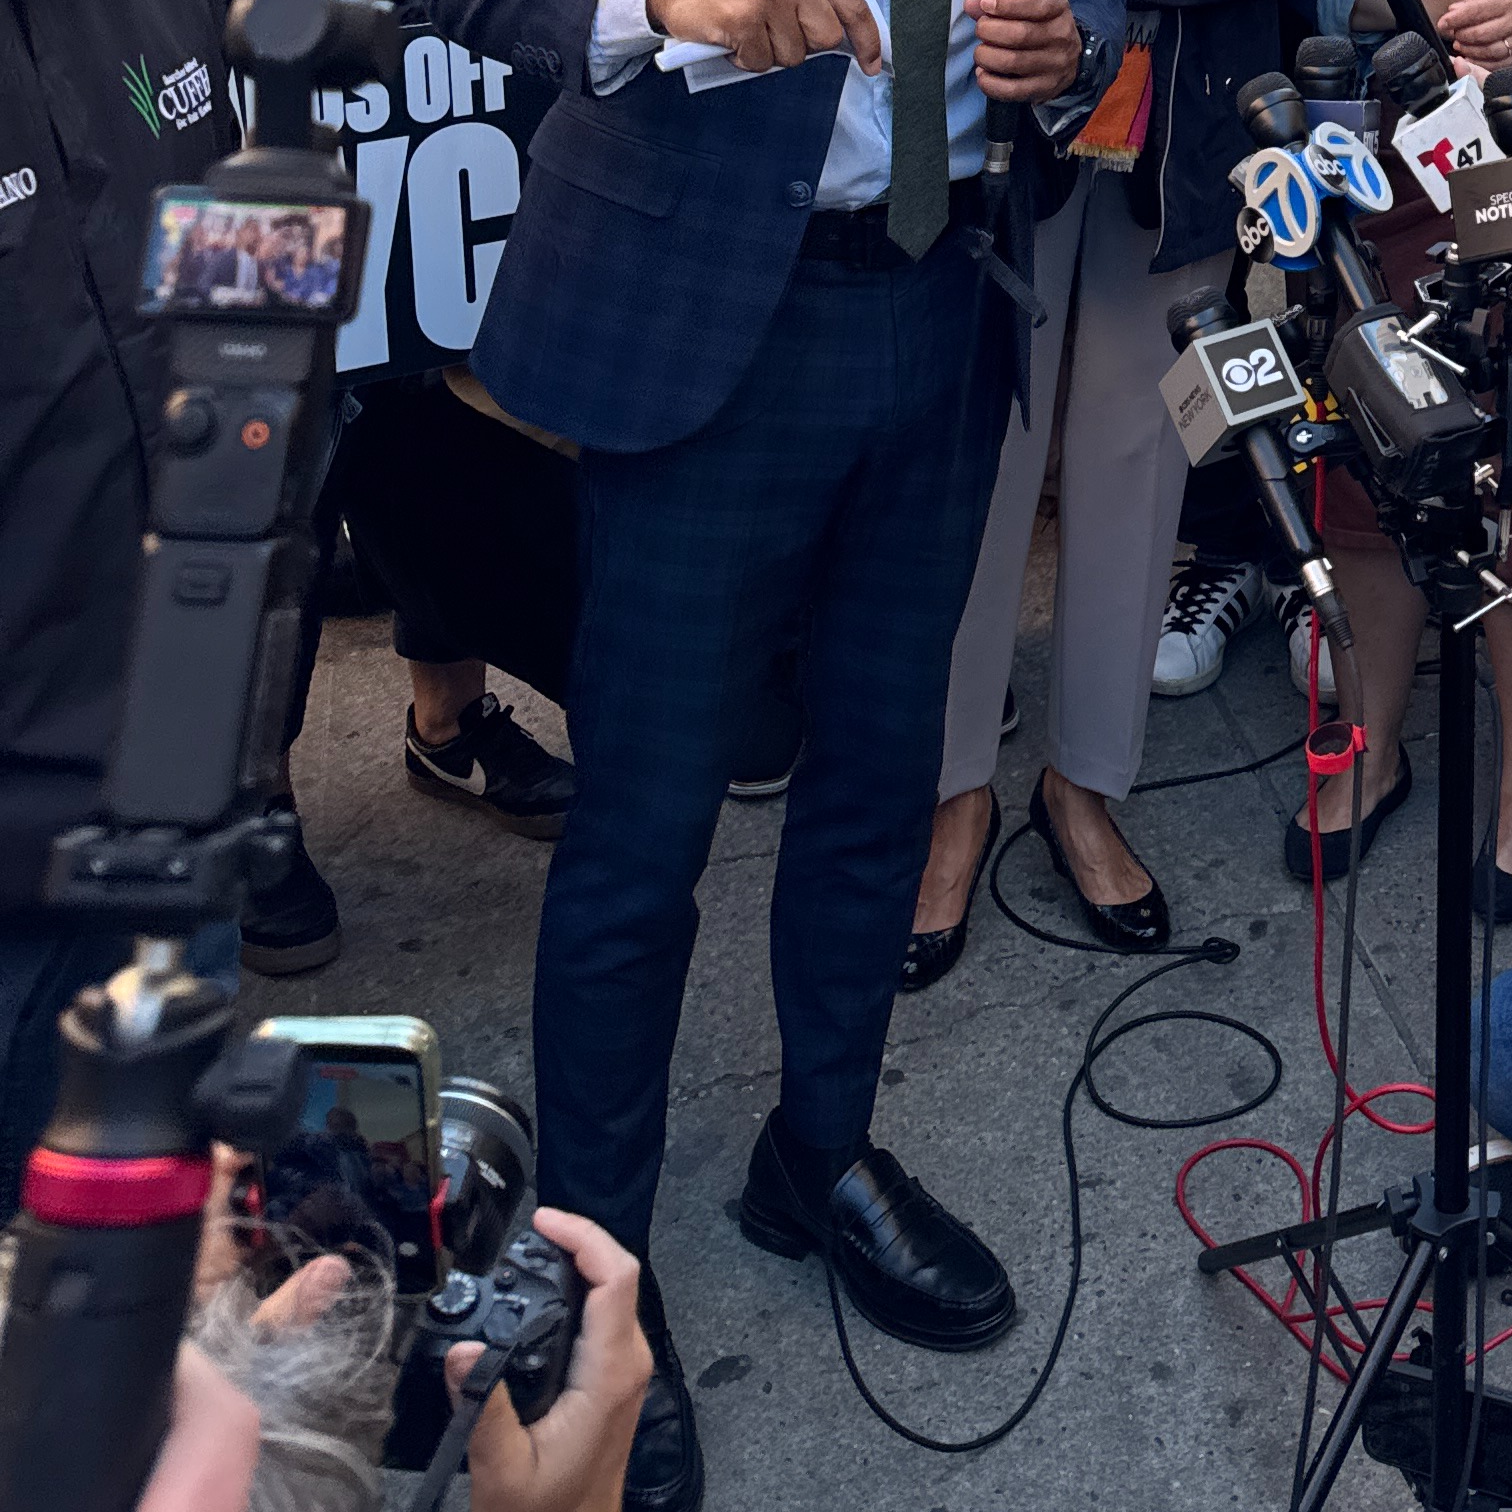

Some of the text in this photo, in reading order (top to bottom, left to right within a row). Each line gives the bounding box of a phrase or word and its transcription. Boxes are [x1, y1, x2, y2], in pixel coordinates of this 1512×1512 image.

[1313, 153, 1347, 176] abc
[1457, 137, 1483, 169] 47
[1239, 217, 1270, 254] abc
[1248, 348, 1284, 387] 2
